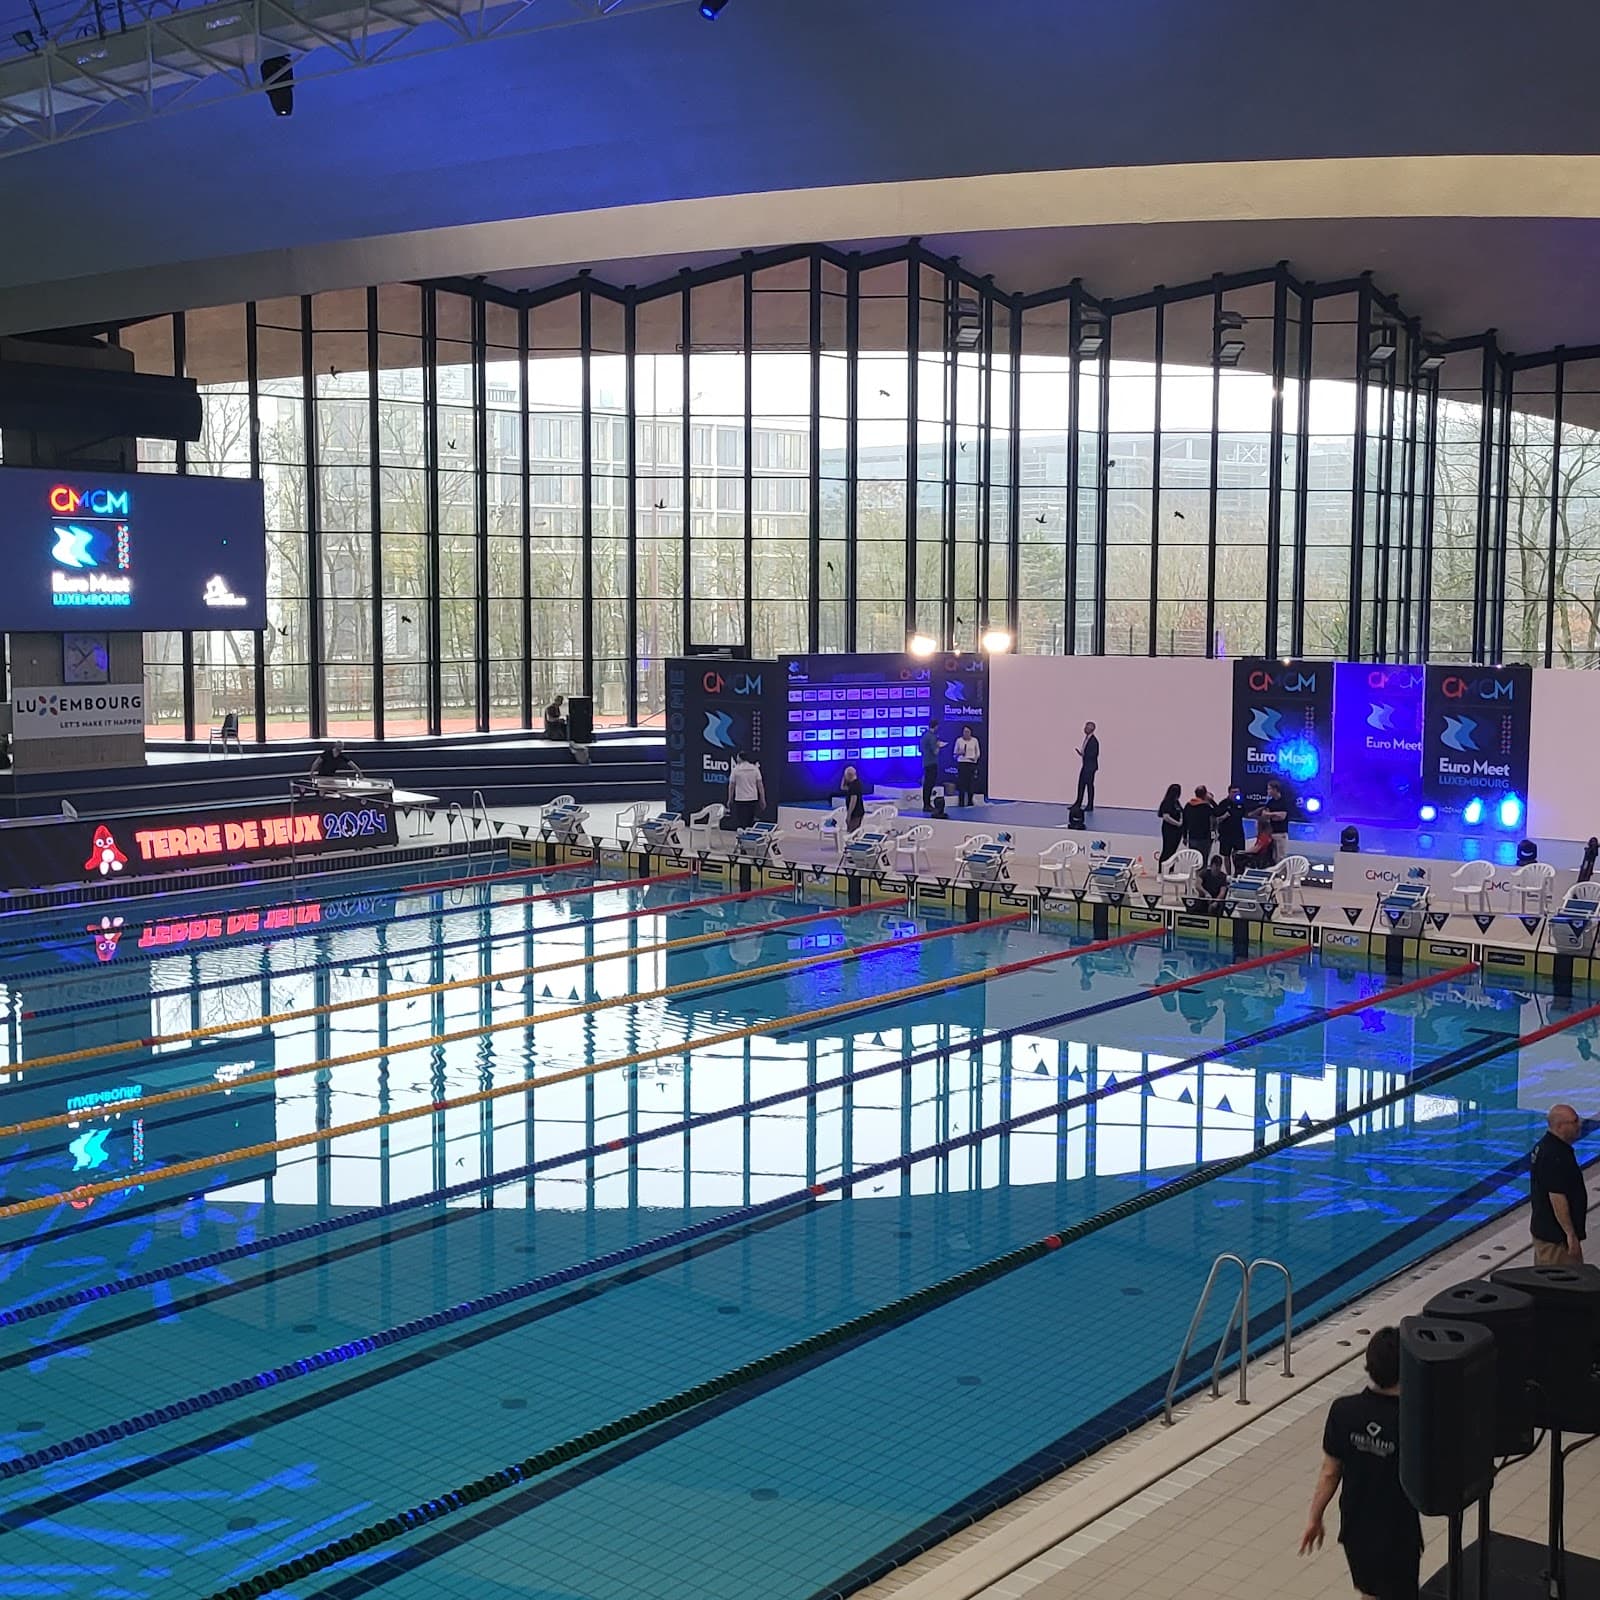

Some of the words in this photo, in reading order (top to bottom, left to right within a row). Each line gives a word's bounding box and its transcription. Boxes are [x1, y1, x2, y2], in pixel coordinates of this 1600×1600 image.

[50, 487, 129, 514] CMCM
[53, 593, 130, 606] LUXEMBOURG
[17, 695, 141, 716] LUXEMBOURG
[82, 720, 102, 728] MAKE
[104, 719, 112, 727] IT
[113, 718, 142, 726] HAPPEN
[671, 669, 685, 812] WELCOME
[1366, 736, 1391, 749] Euro
[1393, 738, 1424, 752] Meet
[703, 754, 729, 771] Euro
[1247, 747, 1276, 762] Euro
[1439, 757, 1471, 774] Euro
[1472, 759, 1510, 777] Meet
[1438, 775, 1510, 789] LUXEMBOURG
[135, 824, 223, 860] TERRE
[224, 820, 260, 851] DE
[261, 814, 322, 846] JEUX
[323, 809, 388, 841] 2024
[1365, 869, 1401, 882] CMCM
[1326, 933, 1360, 945] CMCM
